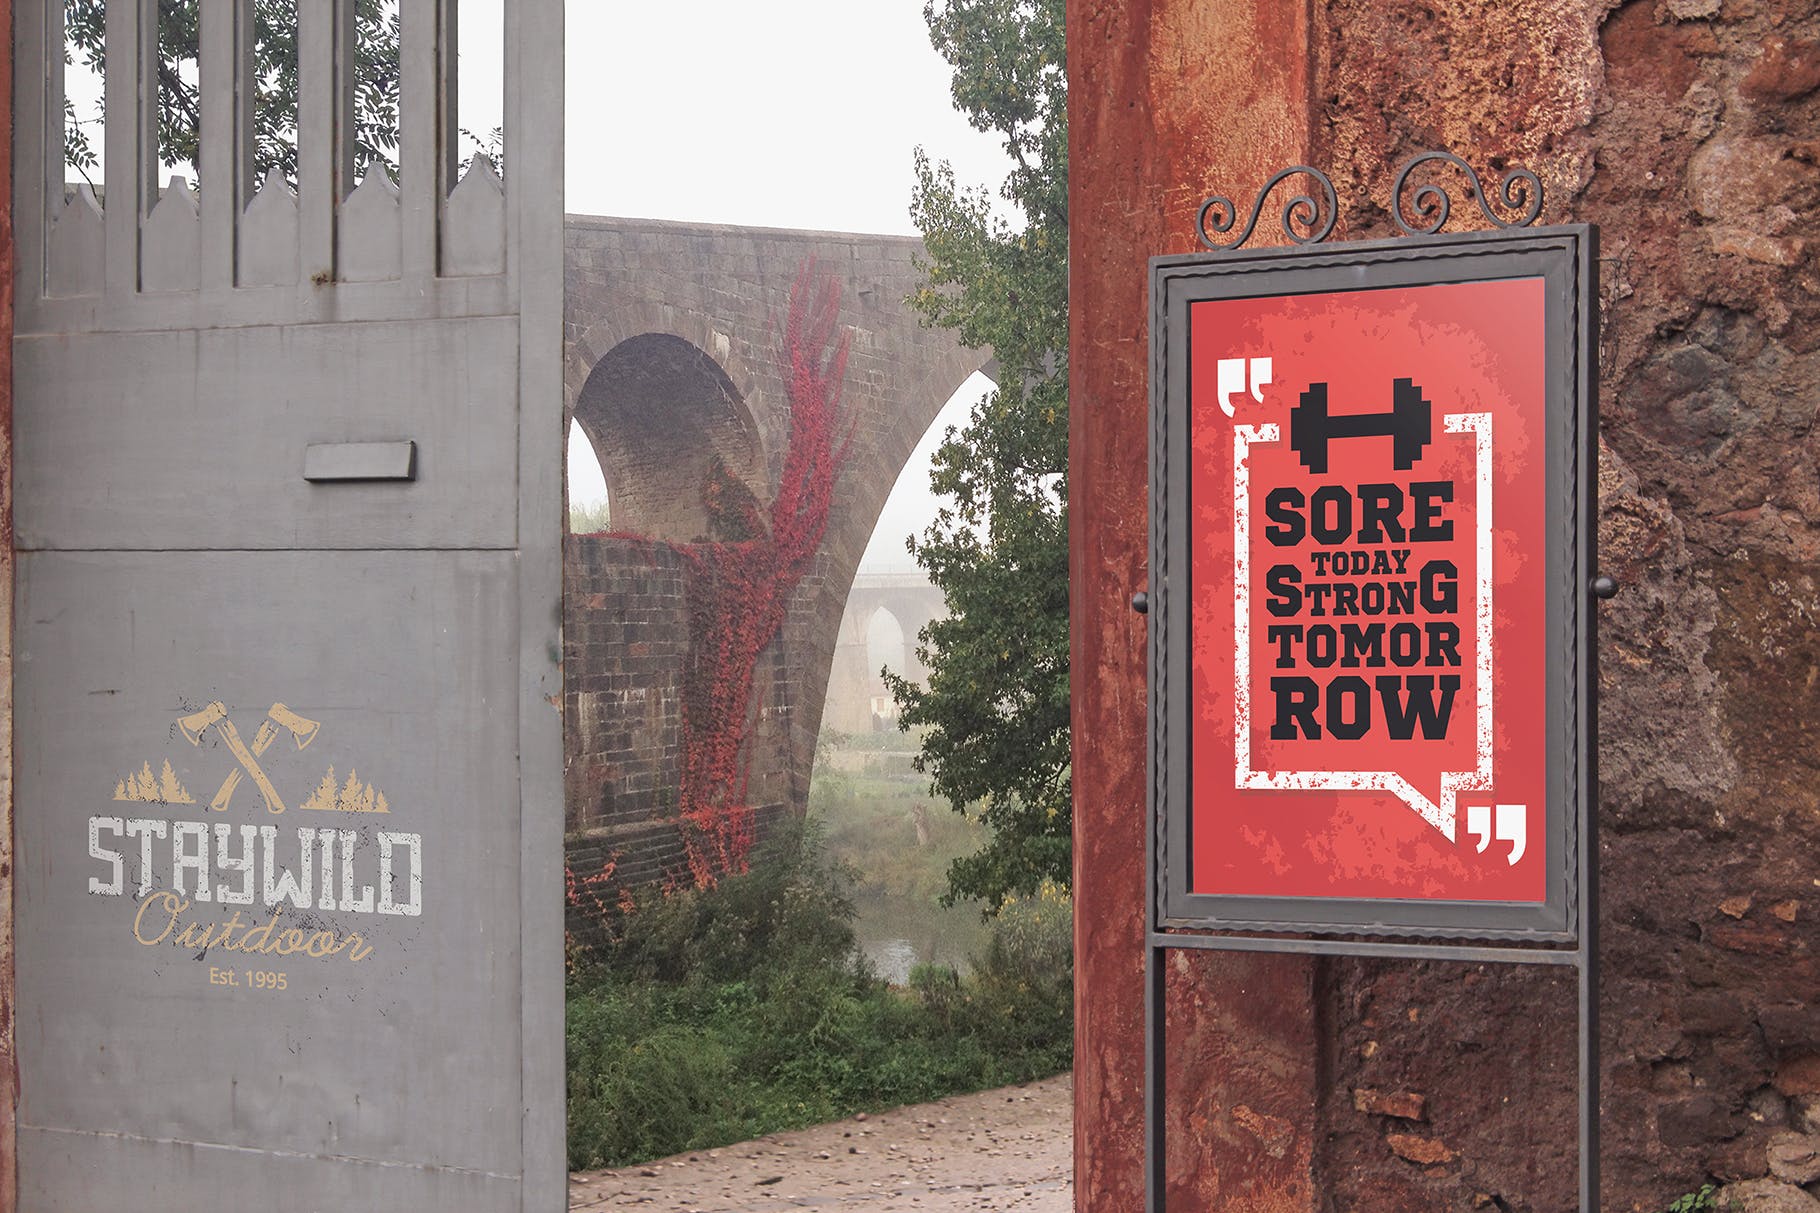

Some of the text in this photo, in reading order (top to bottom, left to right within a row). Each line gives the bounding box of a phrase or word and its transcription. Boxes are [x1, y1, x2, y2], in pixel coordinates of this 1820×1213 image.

[1265, 481, 1454, 547] SORE
[1265, 559, 1458, 618] STRONG
[1310, 549, 1411, 577] TODAY
[1267, 621, 1461, 669] TOMOR
[1269, 674, 1461, 740] ROW
[133, 891, 373, 962] Outdoor
[210, 967, 288, 991] Est. 1995
